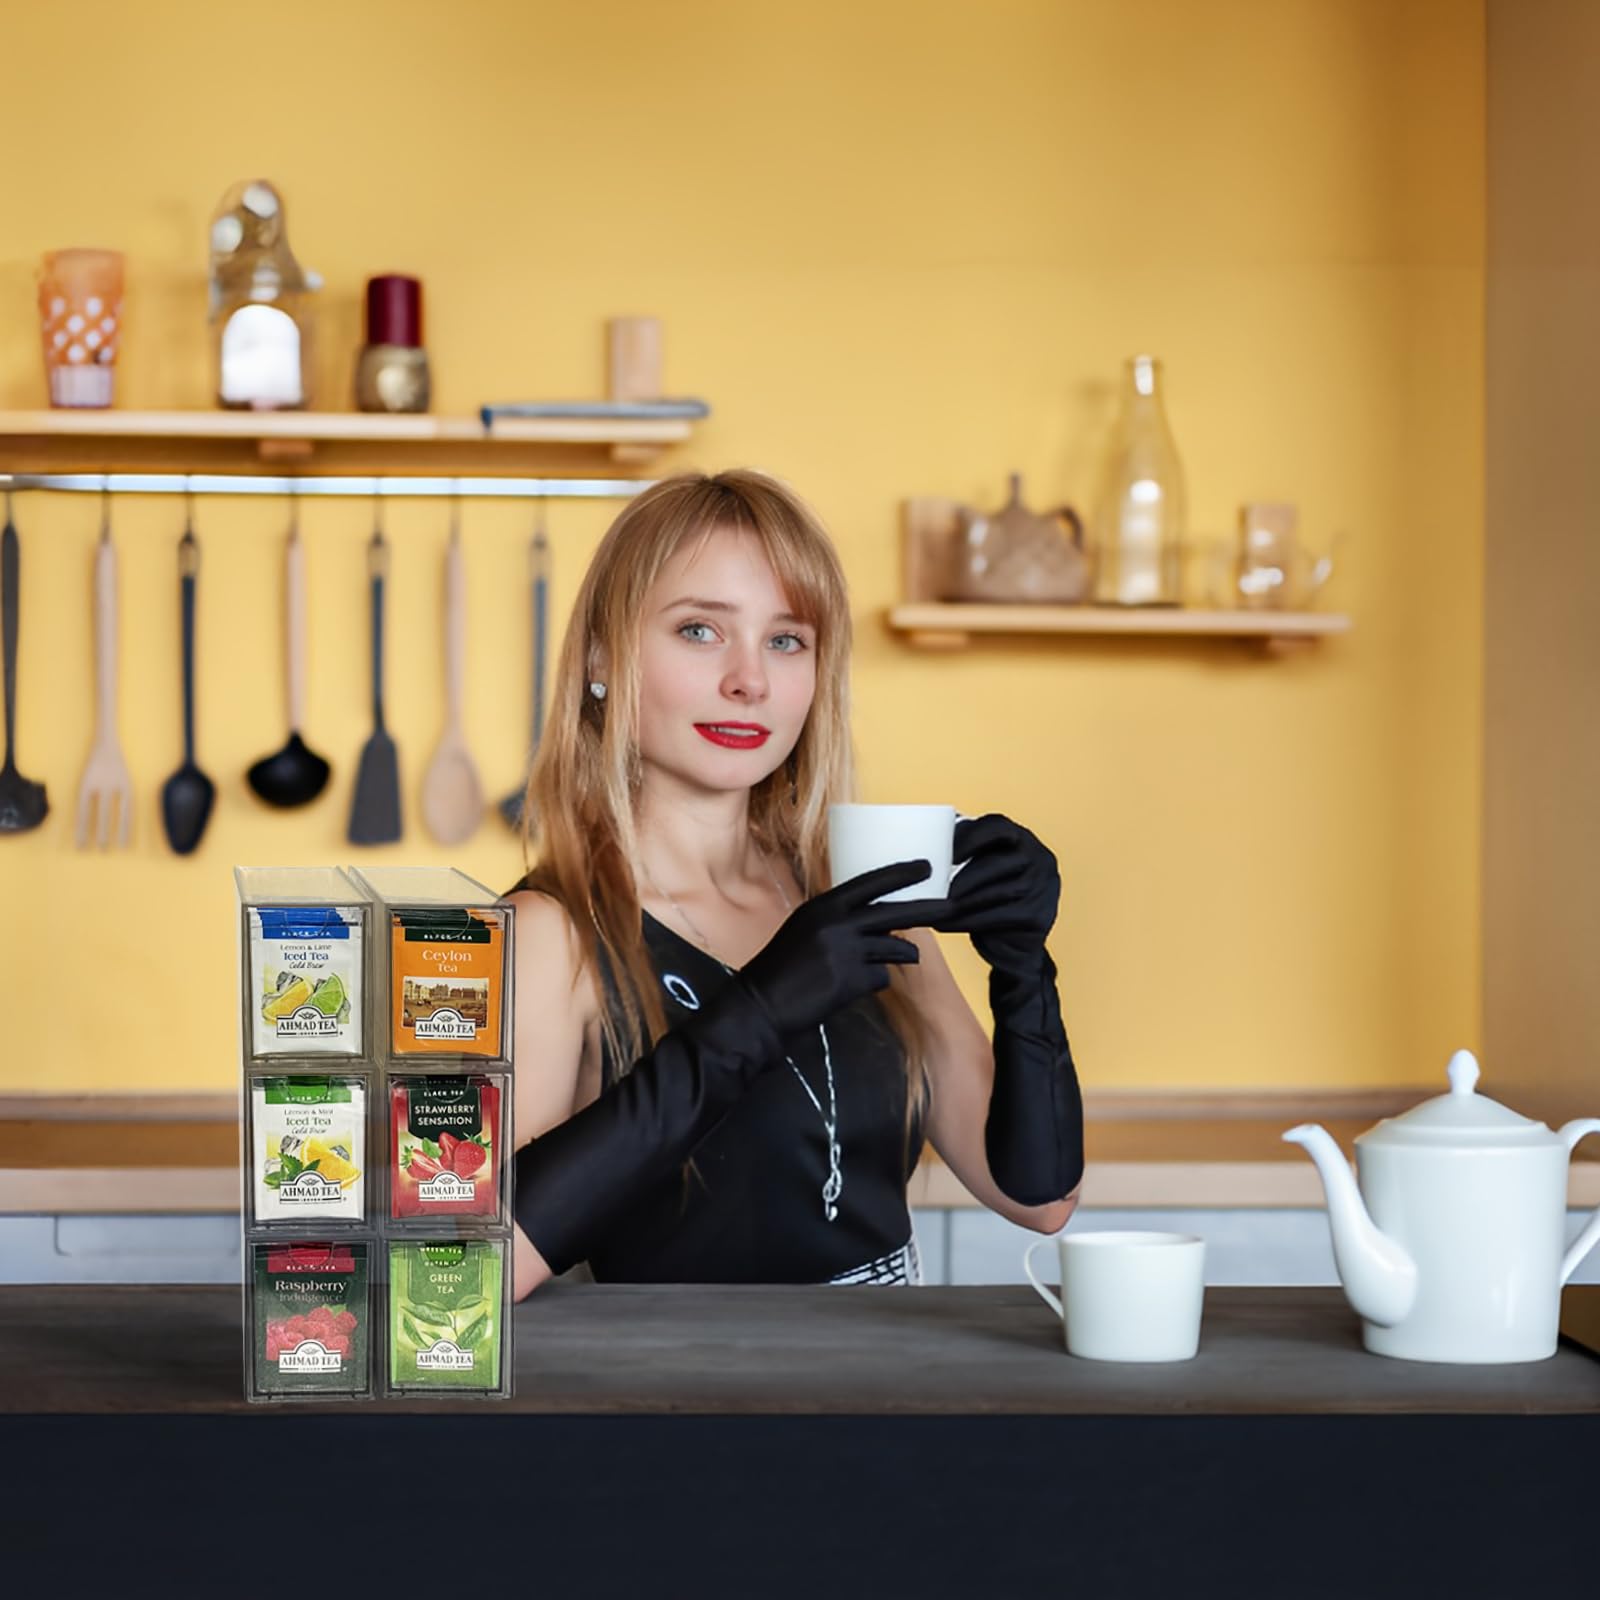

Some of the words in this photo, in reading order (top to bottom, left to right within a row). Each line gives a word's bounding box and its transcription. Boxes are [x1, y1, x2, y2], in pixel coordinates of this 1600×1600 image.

[284, 952, 307, 961] Iced
[309, 952, 329, 961] Tea
[422, 949, 473, 964] Ceylon
[289, 961, 305, 969] Cold
[437, 963, 458, 973] Tea
[279, 1021, 317, 1031] AHMAD
[318, 1020, 337, 1030] TEA
[417, 1024, 454, 1034] AHMAD
[456, 1024, 474, 1034] TEA
[414, 1104, 476, 1115] STRAWBERRY
[286, 1117, 309, 1126] Iced
[312, 1117, 332, 1126] Tea
[417, 1116, 473, 1126] SENSATION
[281, 1187, 319, 1197] AHMAD
[321, 1186, 339, 1196] TEA
[420, 1186, 455, 1195] AHMAD
[456, 1185, 474, 1195] TEA
[429, 1273, 462, 1284] GREEN
[275, 1280, 347, 1294] Raspberry
[437, 1285, 456, 1295] TEA
[281, 1356, 319, 1366] AHMAD
[321, 1356, 339, 1366] TEA
[418, 1354, 453, 1364] AHMAD
[455, 1354, 472, 1364] TEA
